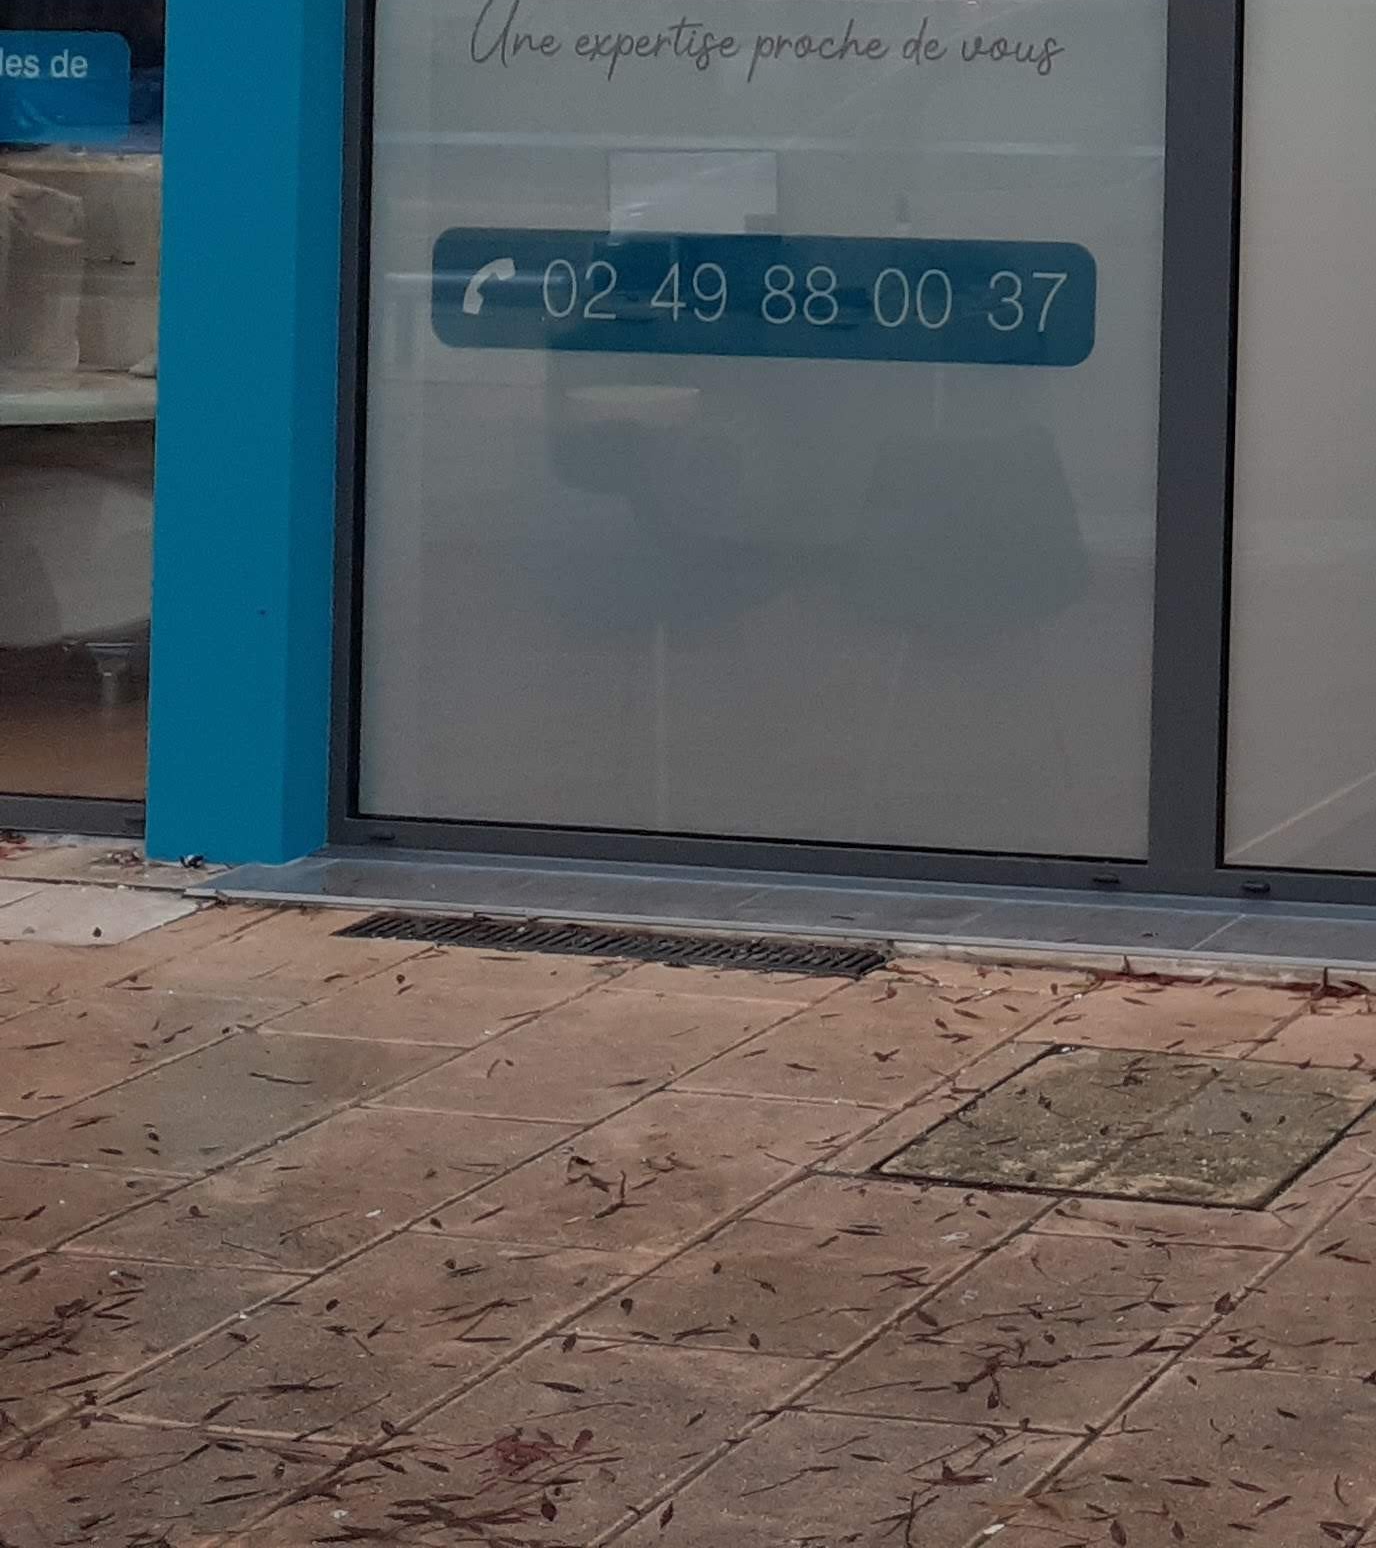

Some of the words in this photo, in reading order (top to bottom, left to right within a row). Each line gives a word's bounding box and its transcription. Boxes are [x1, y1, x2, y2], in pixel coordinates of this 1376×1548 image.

[50, 49, 88, 78] de
[575, 15, 741, 81] expertise
[749, 16, 890, 82] proche
[901, 15, 948, 63] de
[960, 37, 1066, 77] vous
[542, 259, 618, 321] 02
[650, 261, 728, 323] 49
[761, 263, 840, 327] 88
[872, 267, 954, 331] 00
[986, 271, 1068, 333] 37
